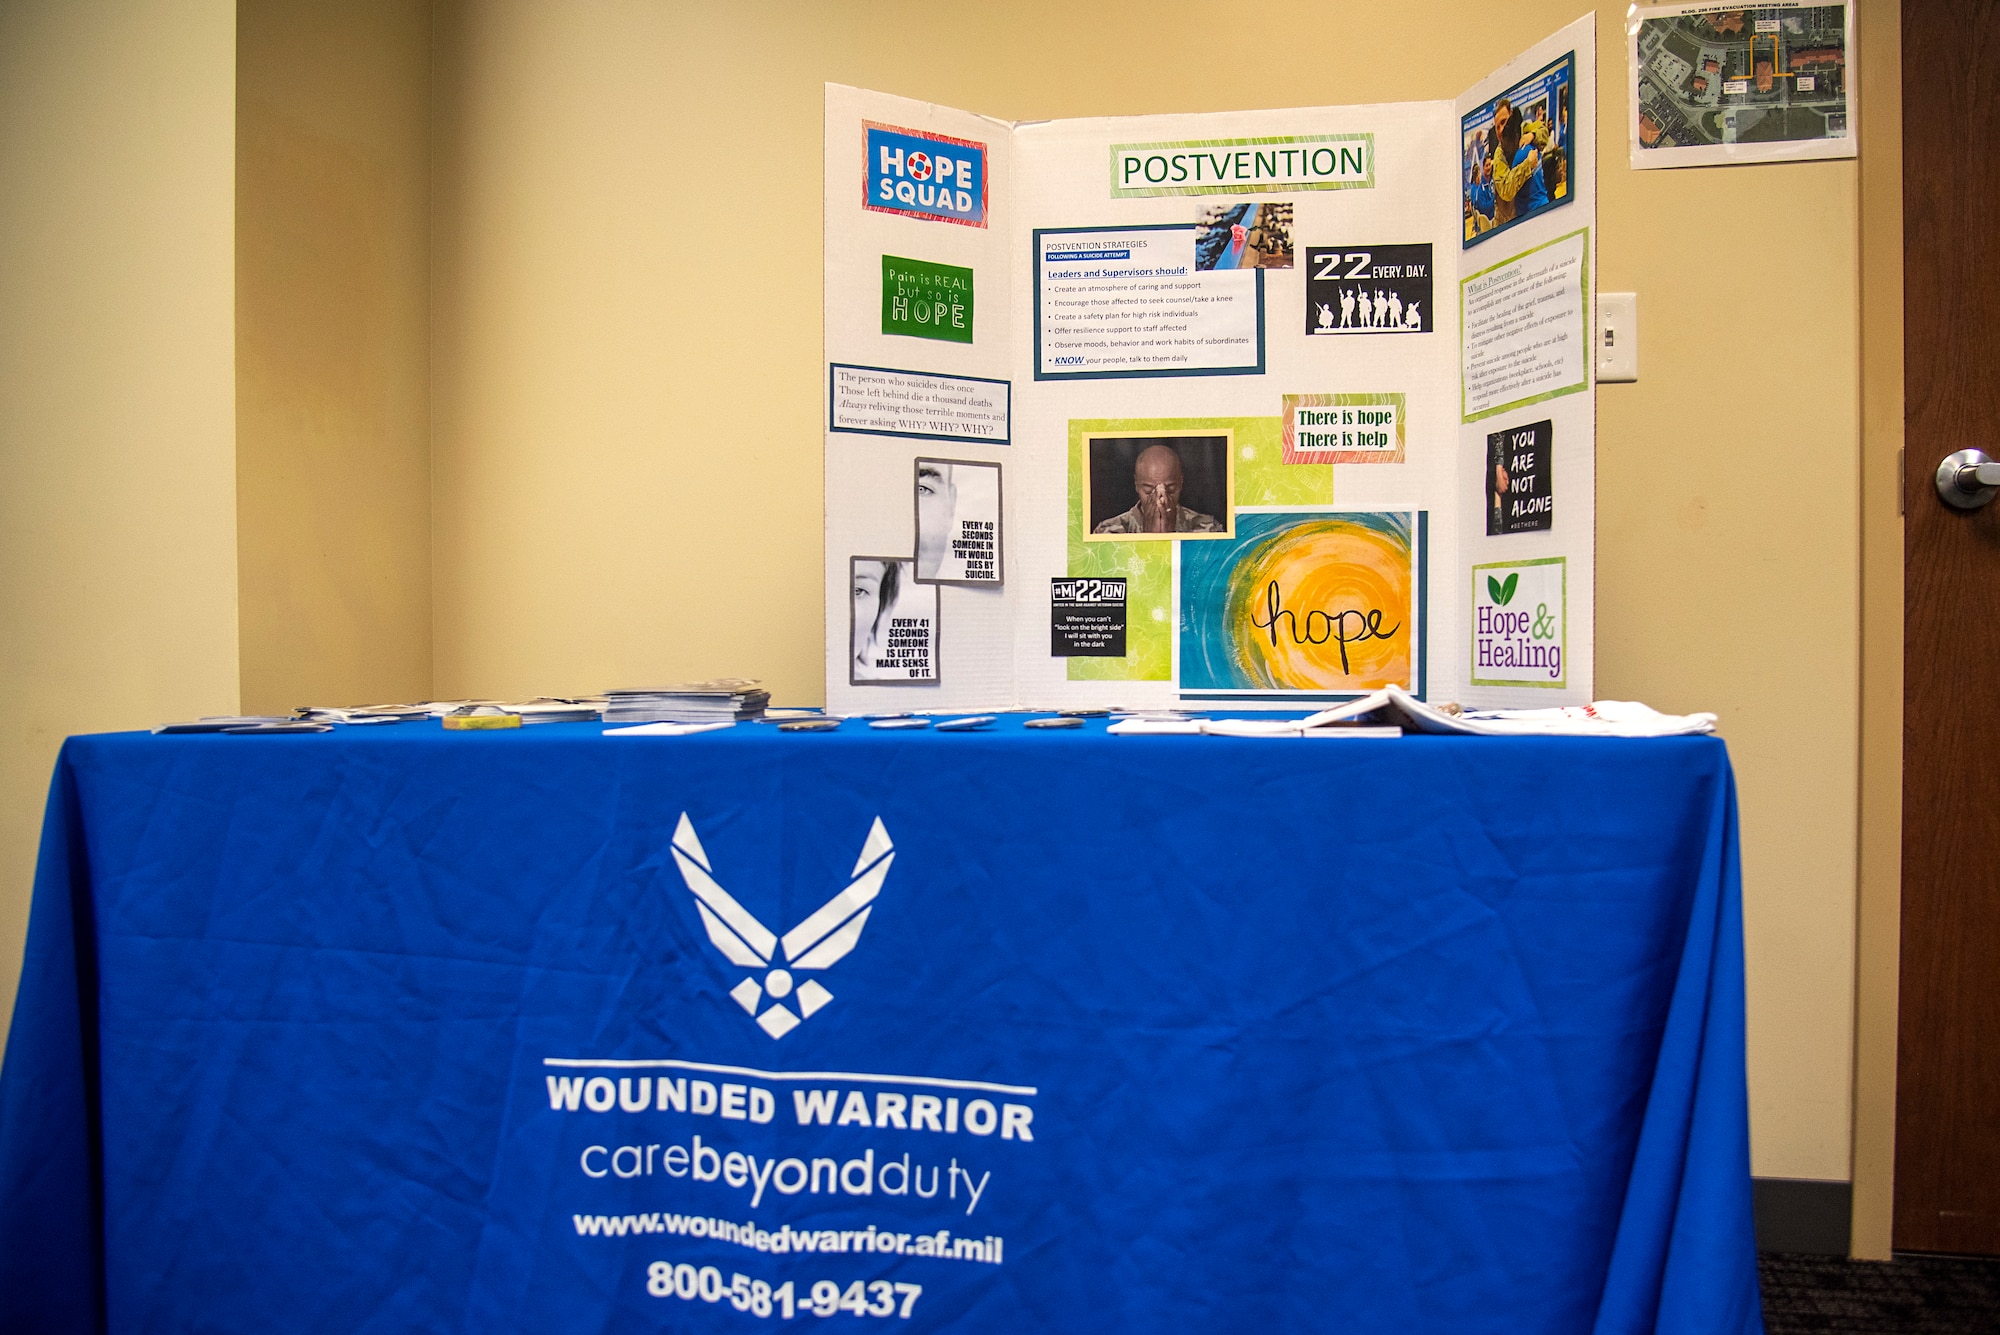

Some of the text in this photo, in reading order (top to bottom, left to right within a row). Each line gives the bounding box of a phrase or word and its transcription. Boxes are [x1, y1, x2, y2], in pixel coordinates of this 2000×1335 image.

[880, 146, 972, 189] HOPE
[1124, 147, 1362, 184] POSTVENTION
[880, 178, 972, 212] SQUAD
[1046, 241, 1147, 250] POSTVENTION STRATEGIES
[1103, 268, 1152, 277] Supervisors
[1155, 267, 1188, 275] should:
[1314, 253, 1427, 280] 22 EVERY. DAY.
[890, 268, 967, 290] Pain is REAL
[898, 281, 959, 303] but so is
[892, 296, 965, 328] HOPE
[1054, 356, 1085, 364] KNOW
[839, 372, 975, 393] The person who suicides dies once
[839, 386, 992, 408] Those left behind die thousand deaths
[838, 400, 1006, 422] Always reliving those terrible moments and
[1298, 410, 1392, 426] There is hope
[838, 415, 994, 435] forever asking WHY? WHY? WHY?
[1298, 431, 1388, 448] There is help
[1512, 430, 1535, 451] YOU
[1511, 452, 1534, 473] ARE
[1511, 474, 1536, 494] NOT
[1511, 495, 1551, 518] ALONE
[962, 521, 994, 530] EVERY 40
[962, 530, 994, 540] SECONDS
[952, 540, 994, 550] SOMEONE IN
[954, 550, 994, 560] THE WORLD
[965, 570, 996, 579] SUICIDE.
[967, 560, 994, 570] DIES BY
[892, 619, 929, 627] EVERY 41
[1251, 580, 1401, 675] hope
[1478, 602, 1555, 640] Hope &
[888, 638, 928, 647] SOMEONE
[889, 628, 929, 638] SECONDS
[886, 649, 928, 657] IS LEFT TO
[1478, 638, 1560, 678] Healing
[876, 659, 929, 668] MAKE SENSE
[909, 669, 931, 678] OF IT.
[546, 1076, 1035, 1142] WOUNDED WARRIOR
[573, 1213, 1004, 1264] www.woundedwarrior.af.mil
[646, 1261, 923, 1320] 800-581-9437
